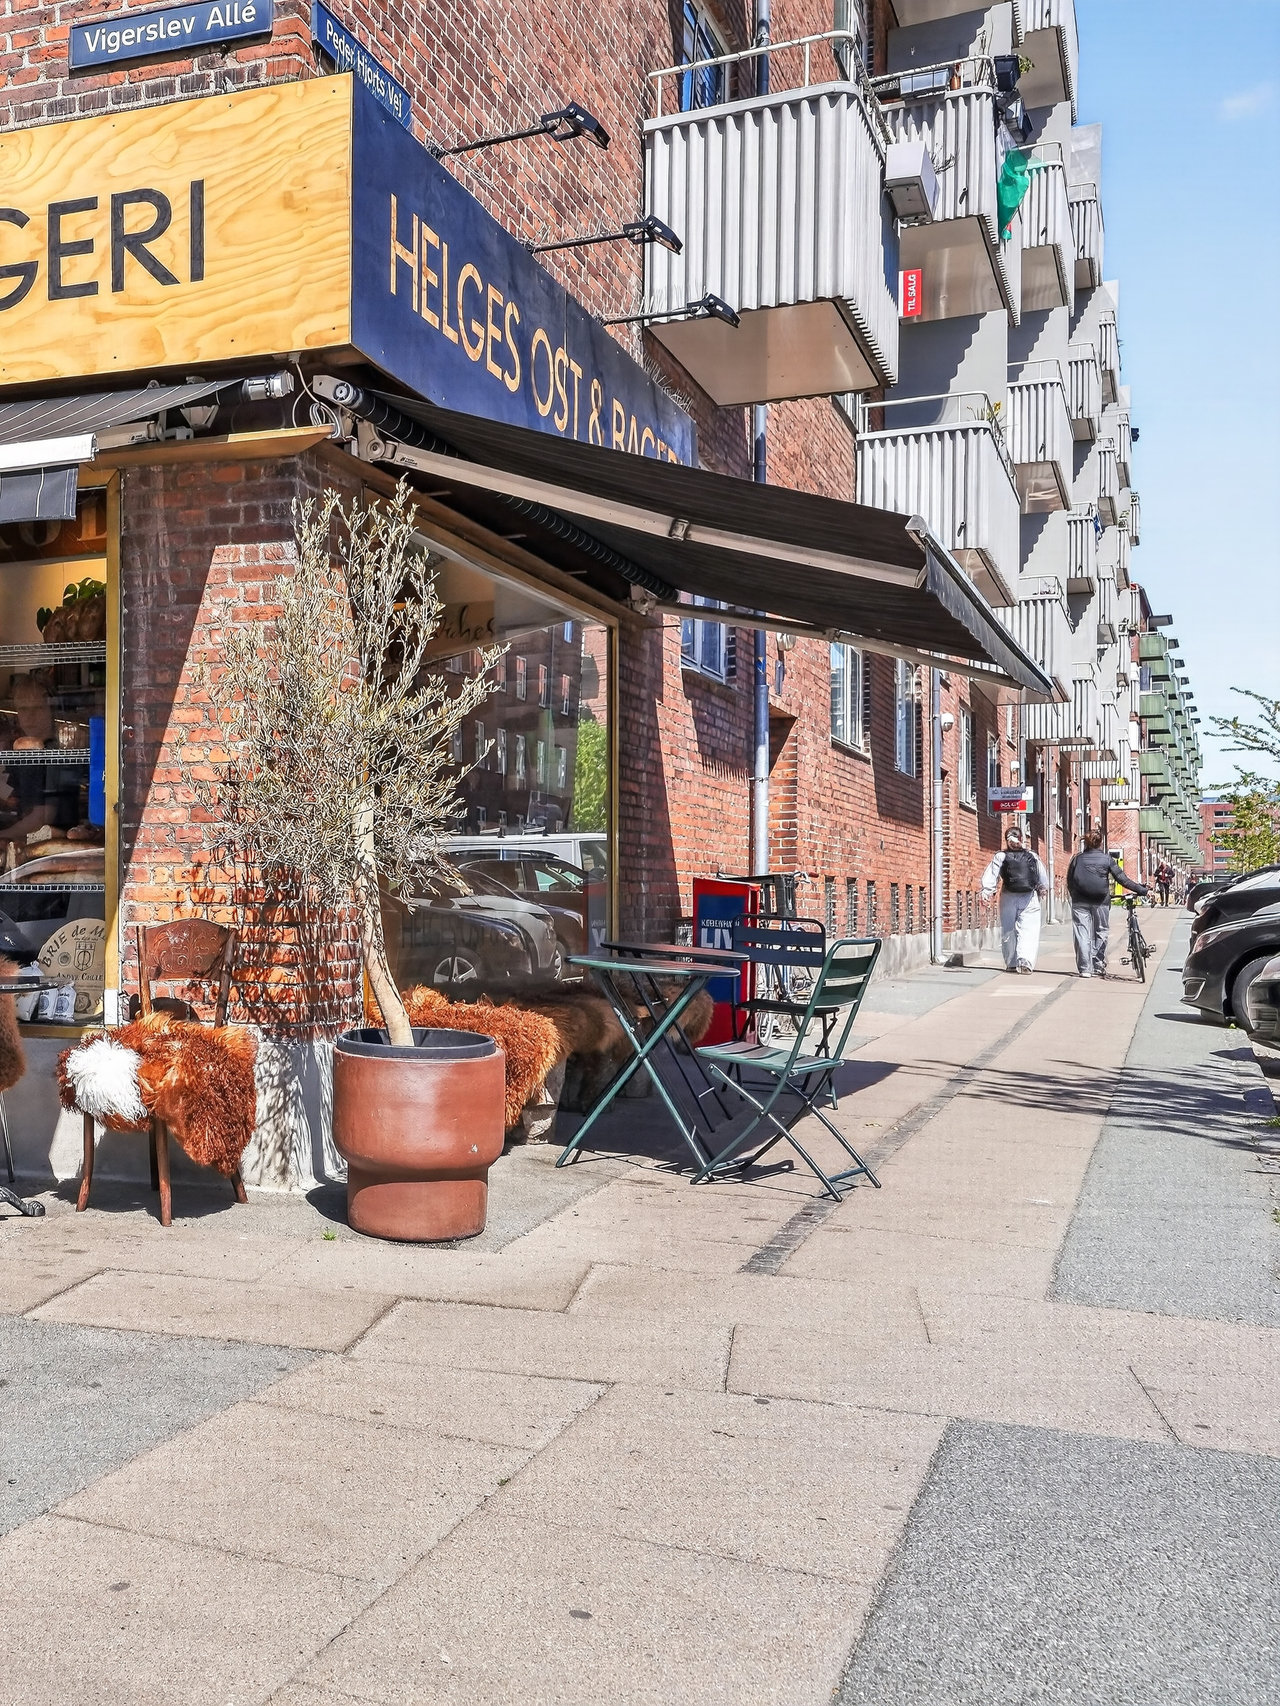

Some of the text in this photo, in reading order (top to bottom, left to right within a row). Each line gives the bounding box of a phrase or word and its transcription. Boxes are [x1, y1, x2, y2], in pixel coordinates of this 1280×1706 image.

[84, 0, 257, 54] Vigerslev Allé
[326, 19, 402, 118] Peder Hjorts Vej
[389, 192, 522, 393] HELGES
[530, 328, 583, 440] OST
[588, 378, 604, 446] &
[907, 274, 917, 312] TIL SALG
[42, 932, 68, 968] BRIE
[71, 925, 86, 938] de
